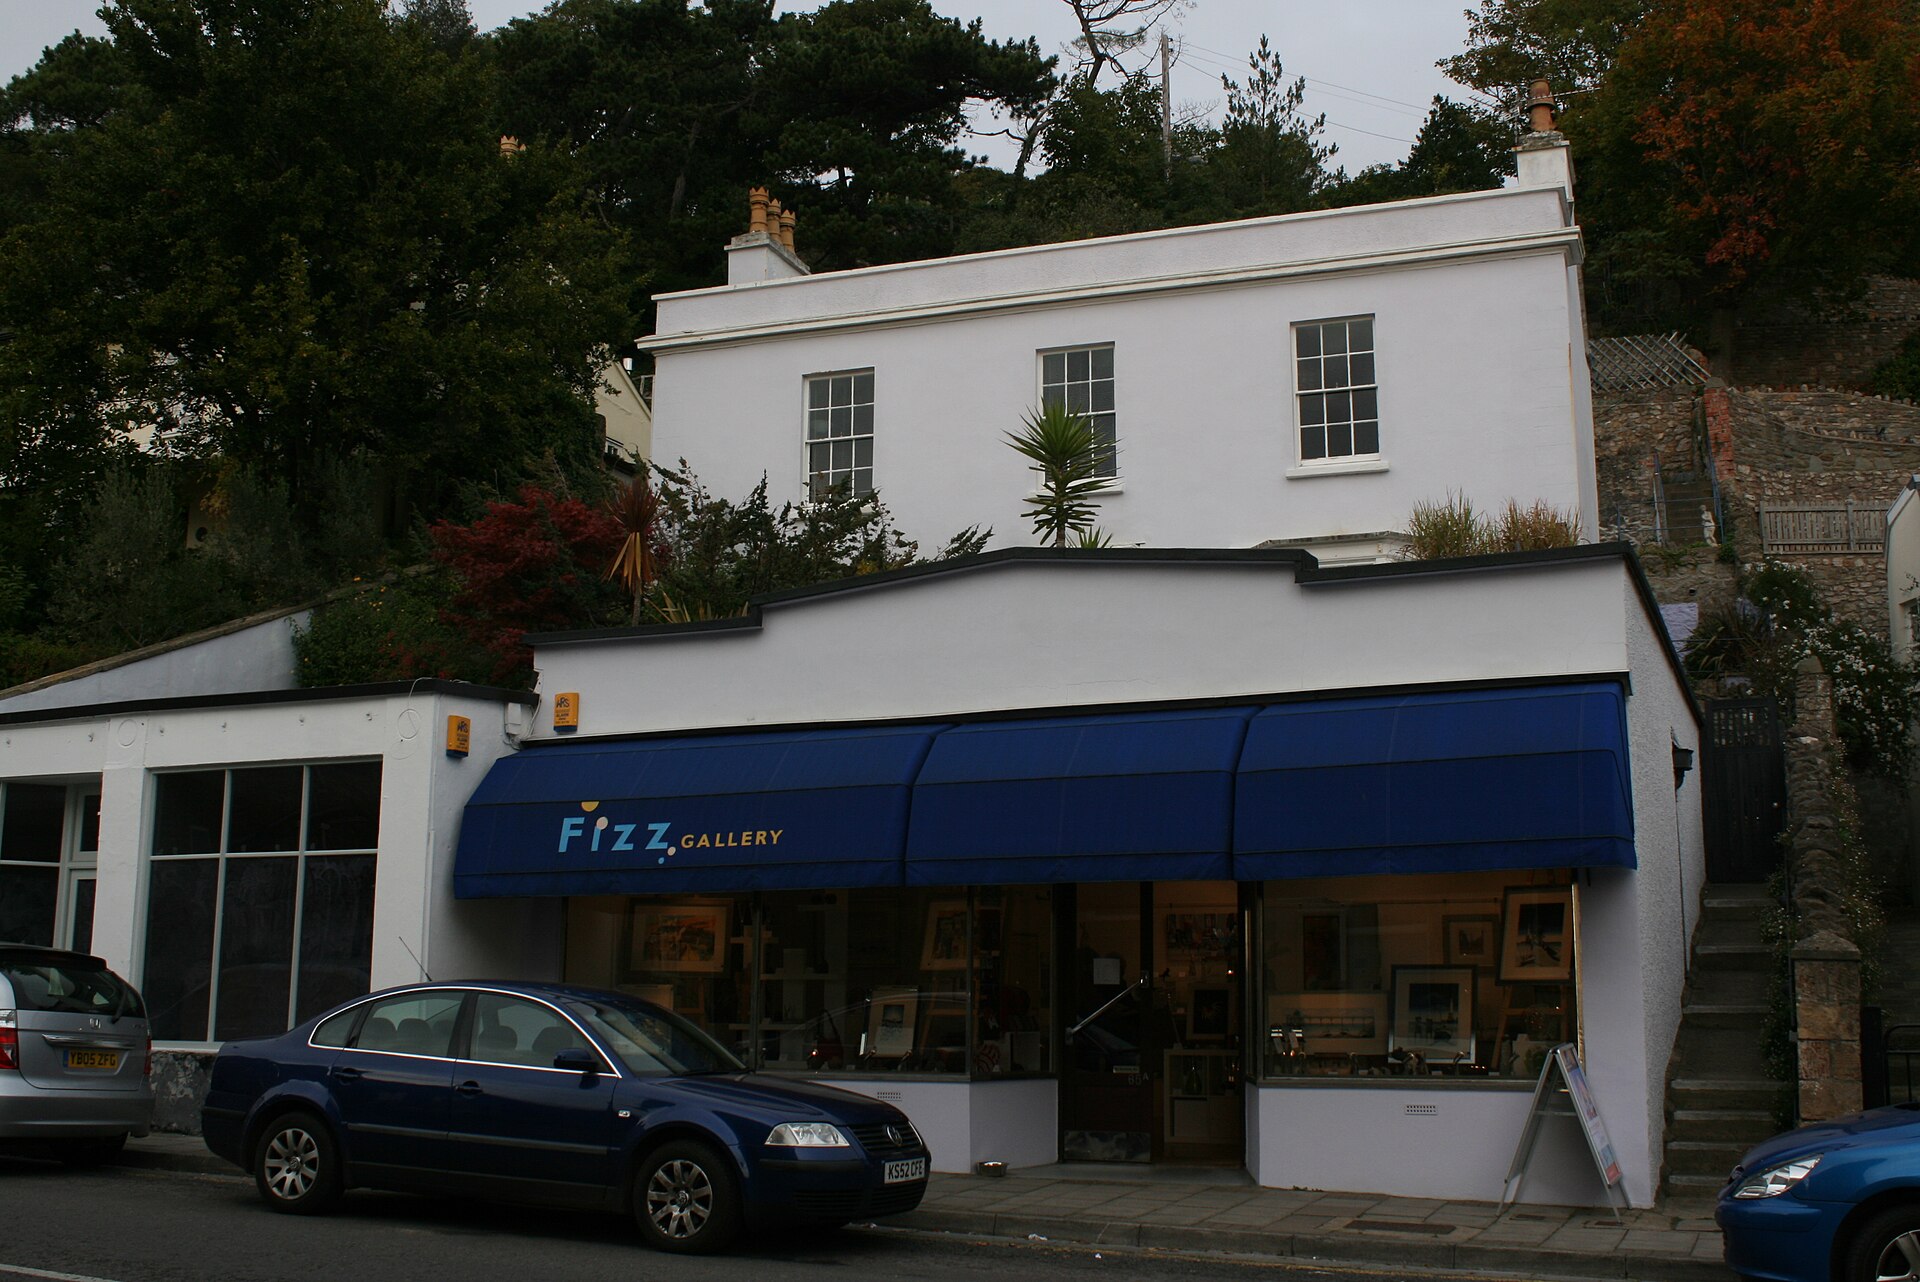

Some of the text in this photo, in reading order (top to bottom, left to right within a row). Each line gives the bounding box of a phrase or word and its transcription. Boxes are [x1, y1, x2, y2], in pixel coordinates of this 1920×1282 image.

[681, 829, 784, 849] GALLERY
[888, 1160, 923, 1180] KS52 CFE
